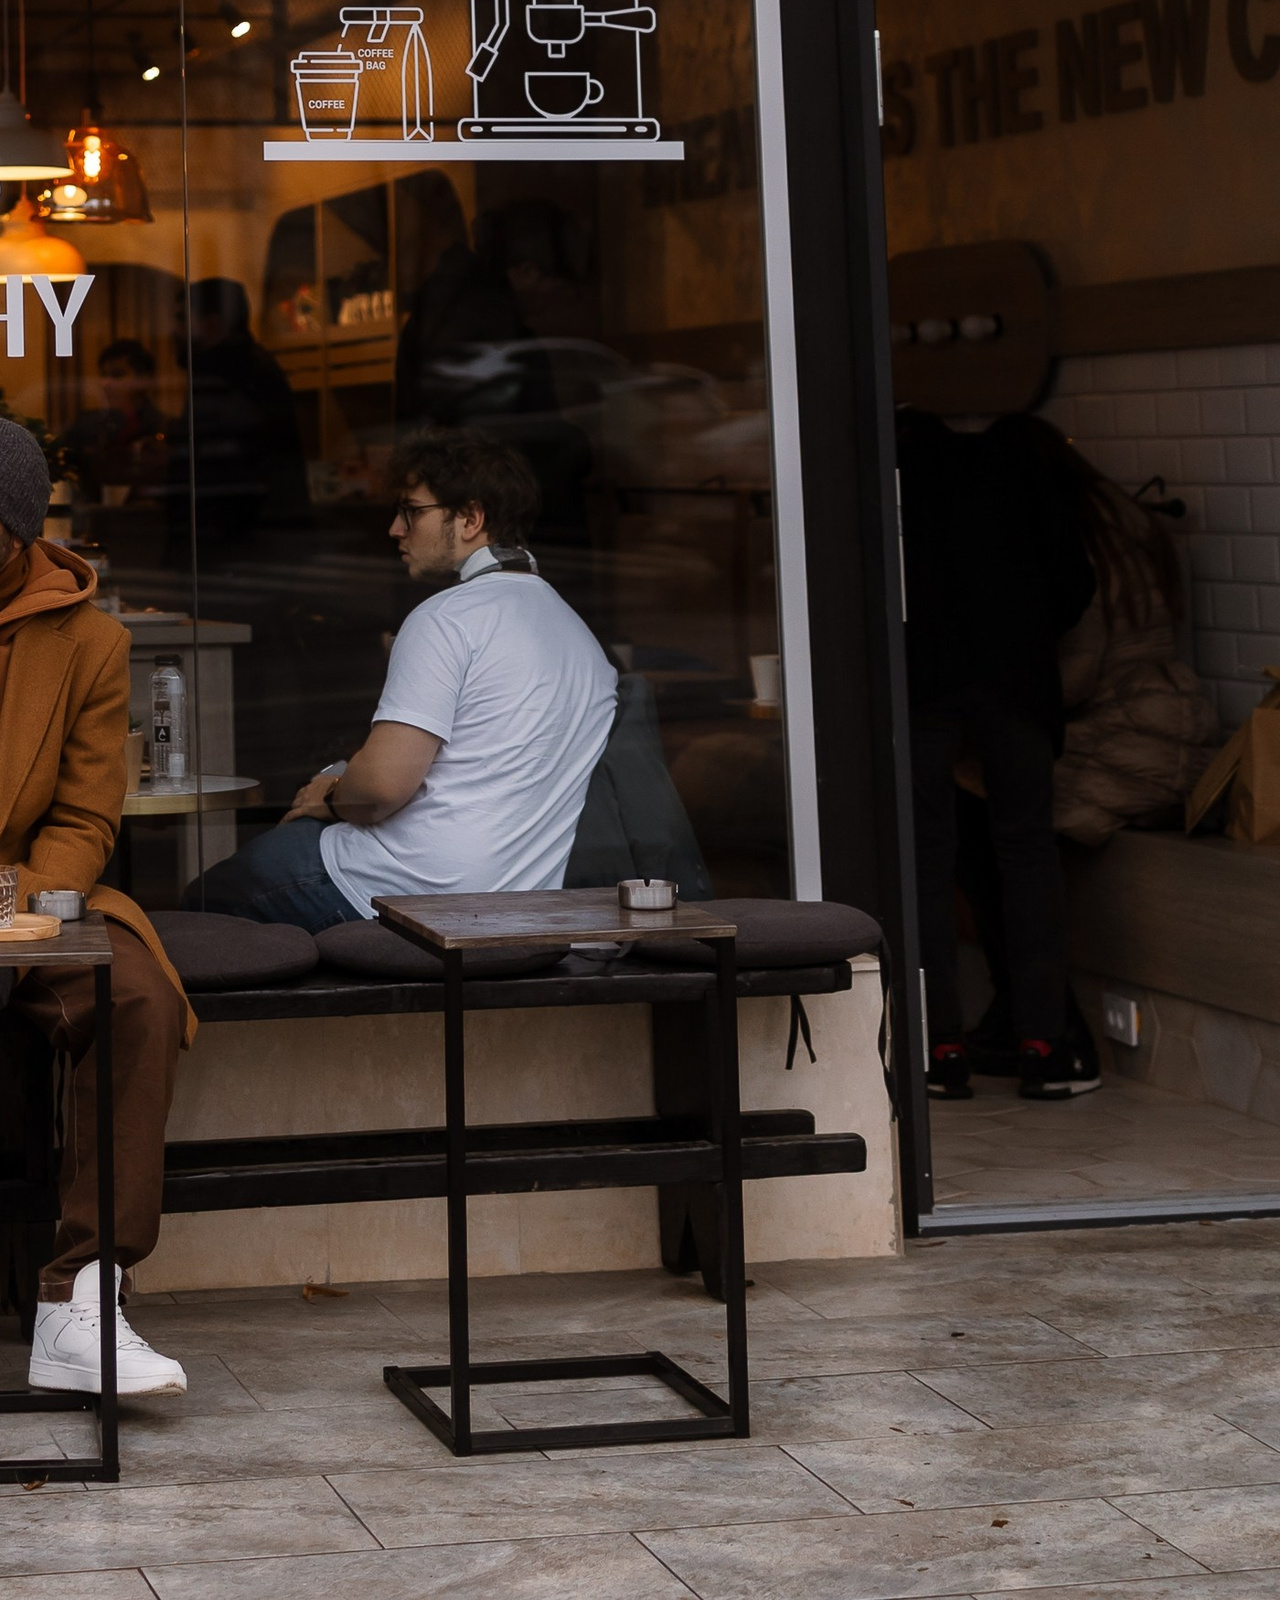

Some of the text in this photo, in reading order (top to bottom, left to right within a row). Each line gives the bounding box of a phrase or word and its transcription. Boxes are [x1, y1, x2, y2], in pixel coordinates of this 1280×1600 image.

[357, 49, 395, 58] COFFEE
[366, 61, 386, 70] BAG
[923, 28, 1044, 149] THE
[308, 100, 345, 109] COFFEE
